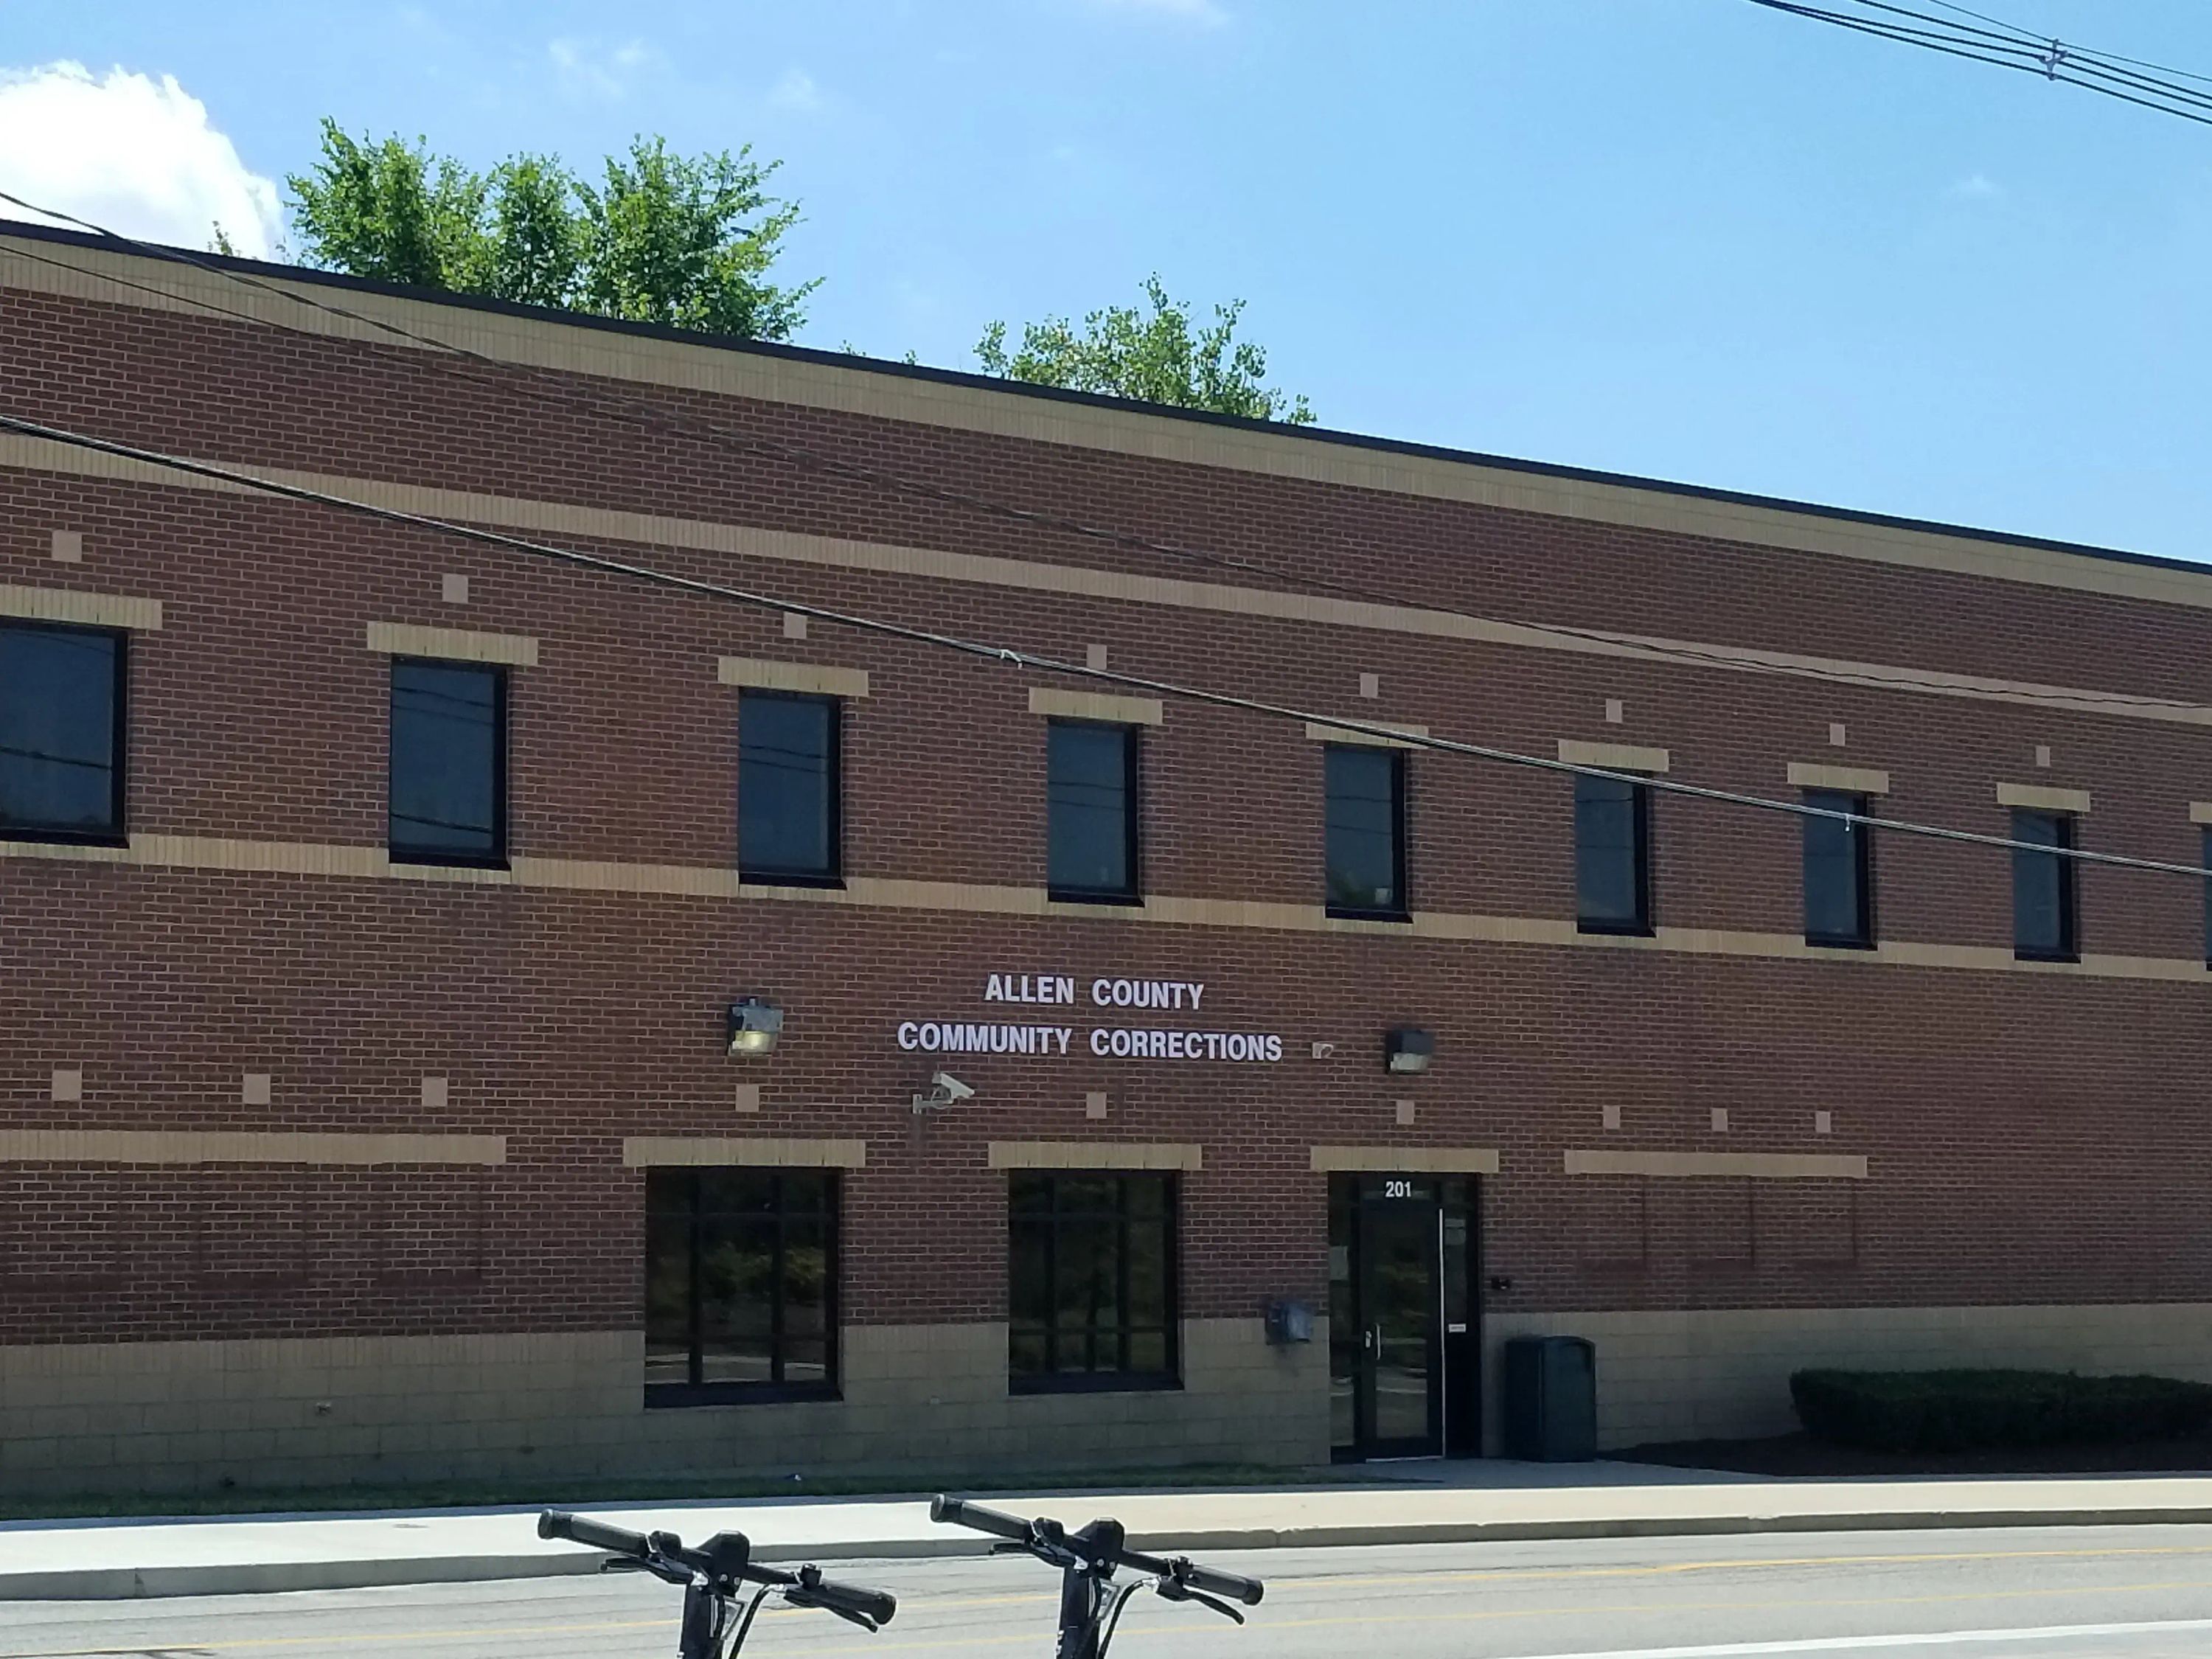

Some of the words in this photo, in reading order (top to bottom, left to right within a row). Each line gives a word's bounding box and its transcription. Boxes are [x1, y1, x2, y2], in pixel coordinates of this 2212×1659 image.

[984, 974, 1074, 1004] ALLEN
[1092, 979, 1204, 1009] COUNTY
[897, 1021, 1072, 1054] COMMUNITY
[1090, 1029, 1282, 1061] CORRECTIONS
[1385, 1181, 1412, 1197] 201
